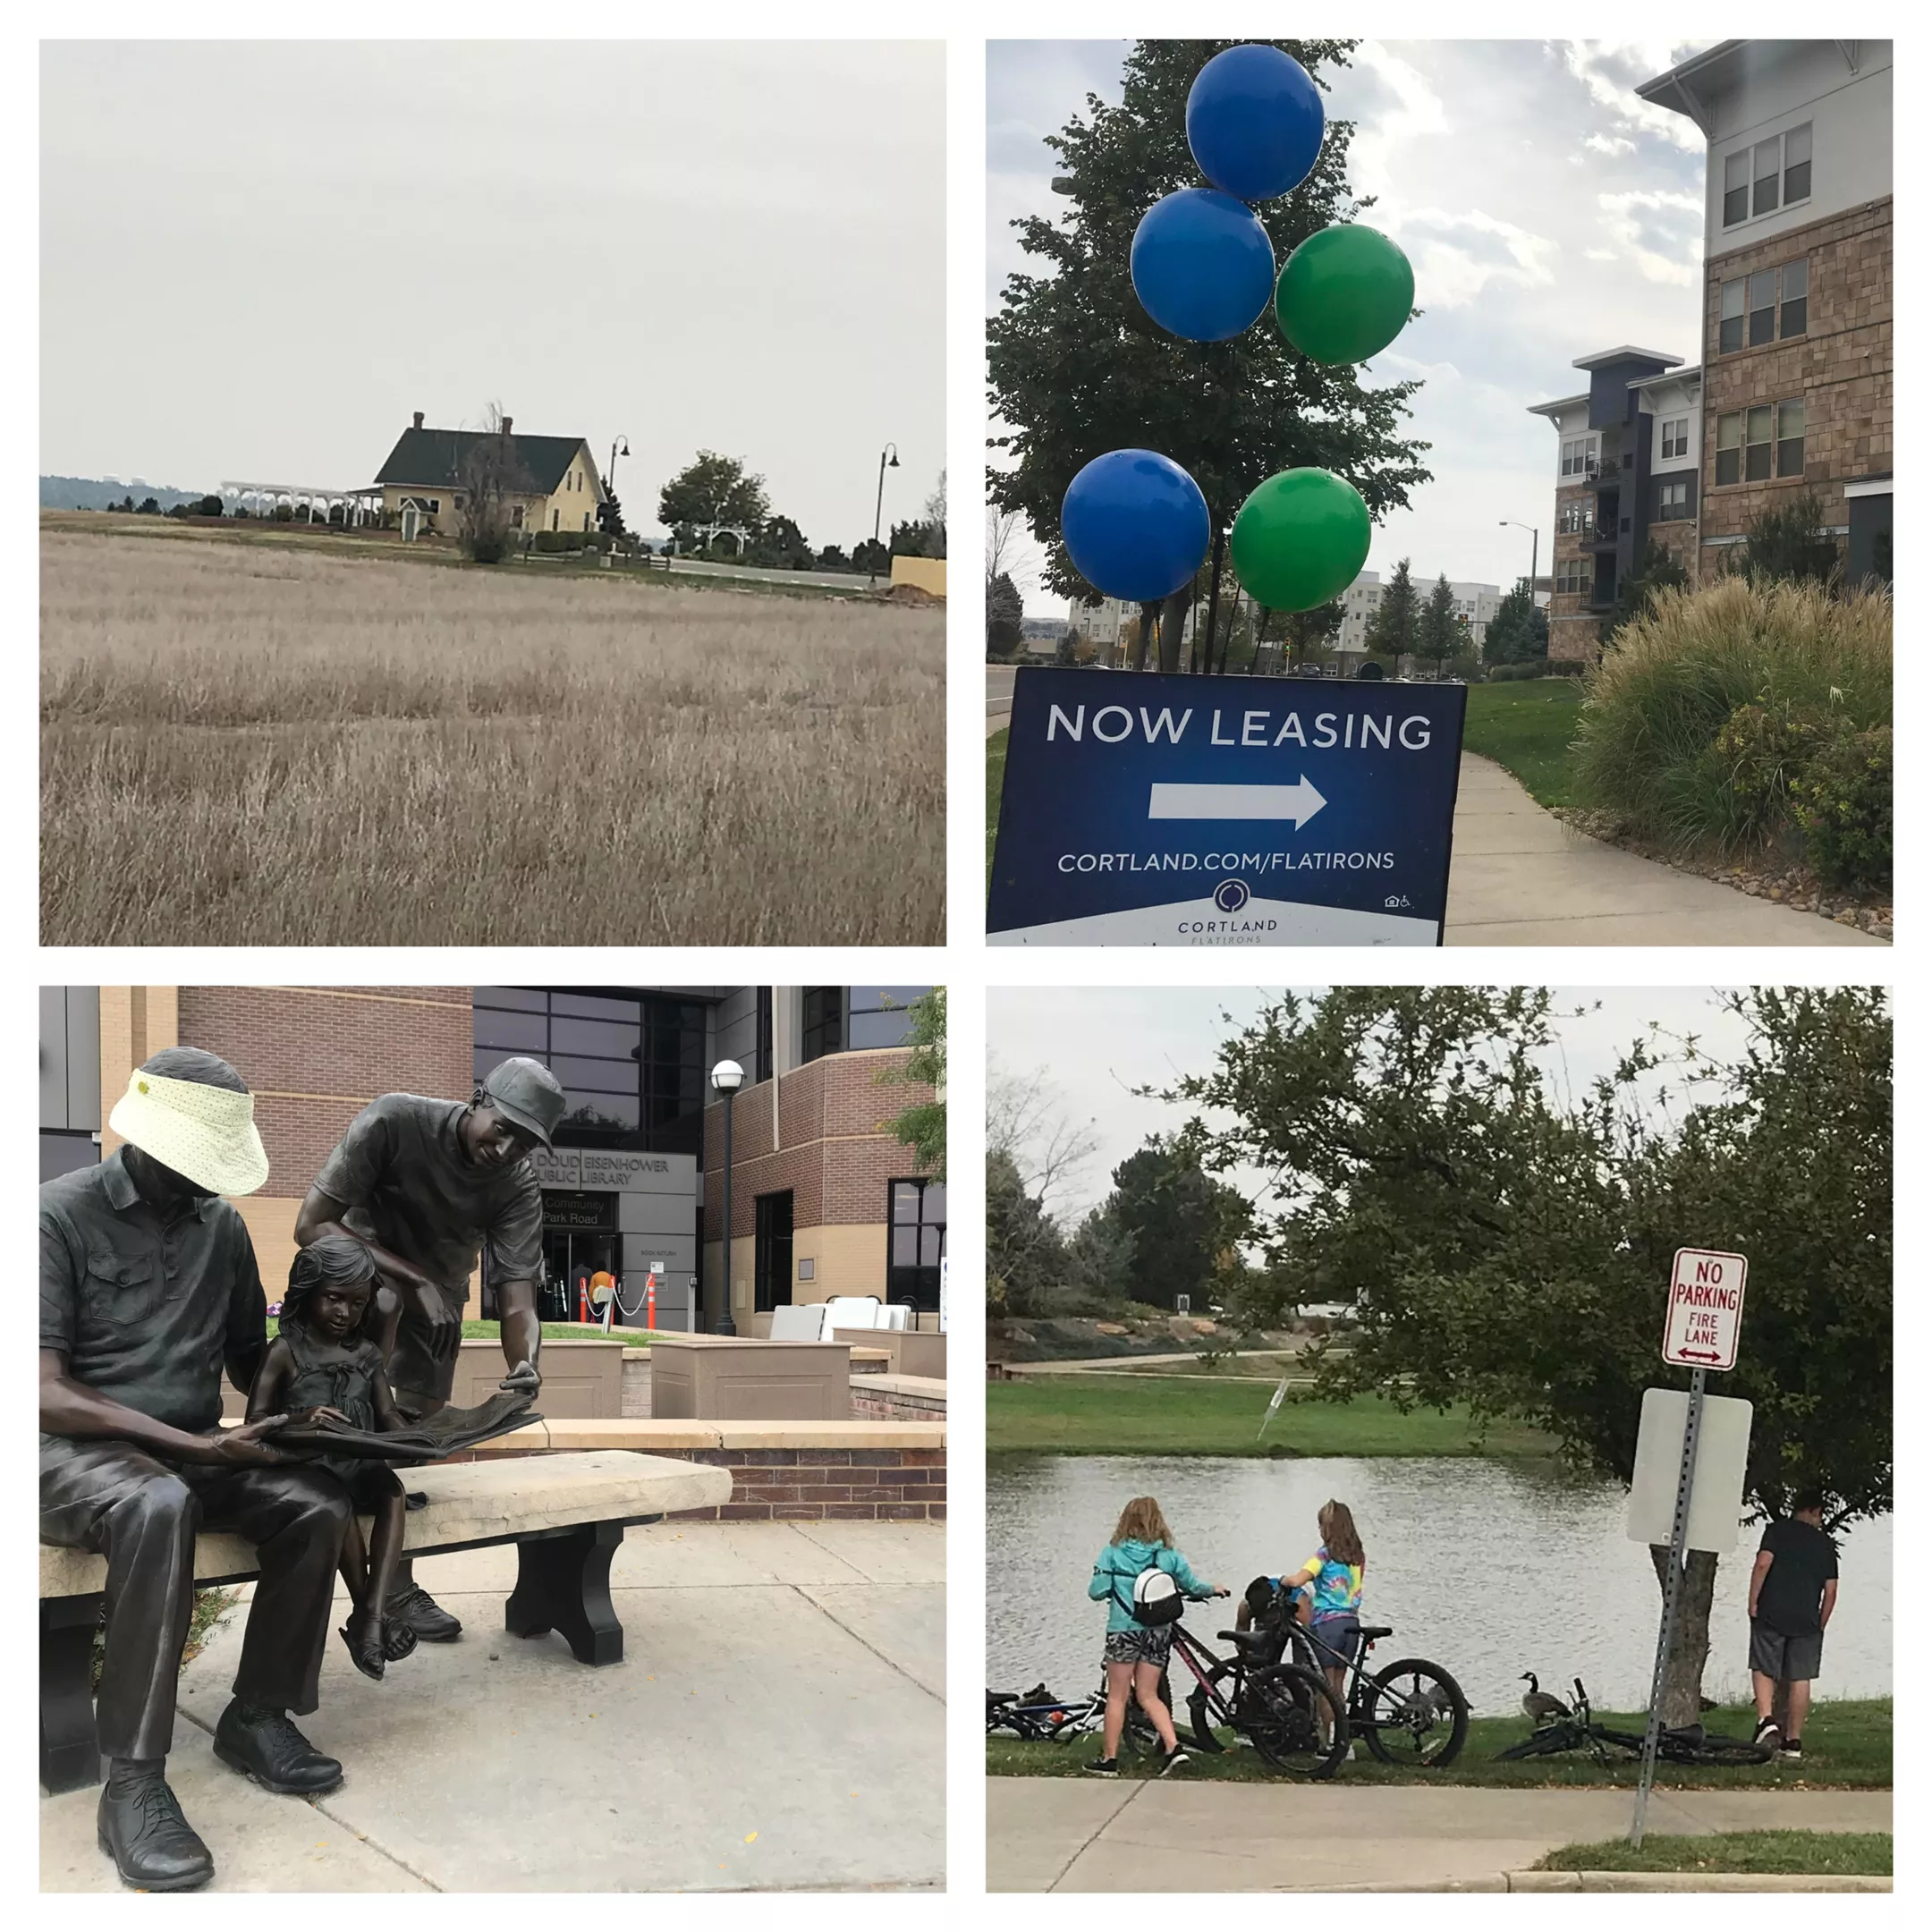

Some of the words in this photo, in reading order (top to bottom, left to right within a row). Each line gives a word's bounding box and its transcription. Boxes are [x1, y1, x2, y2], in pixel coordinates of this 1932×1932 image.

[1046, 704, 1193, 744] NOW
[1210, 709, 1431, 750] LEASING
[1057, 852, 1394, 874] CORTLAND.COM/FLATIRONS
[1178, 919, 1277, 933] CORTLAND
[1191, 936, 1261, 945] FLATIRONS
[538, 1154, 580, 1168] DOUD
[584, 1157, 669, 1173] EISENHOWER
[535, 1169, 576, 1183] UBLIC
[580, 1172, 632, 1185] LIBRARY
[545, 1197, 605, 1213] Community
[543, 1212, 567, 1223] Park
[570, 1213, 597, 1224] Road
[1696, 1261, 1723, 1284] NO
[1675, 1284, 1738, 1310] PARKING
[1689, 1312, 1718, 1328] FIRE
[1685, 1329, 1718, 1345] LANE
